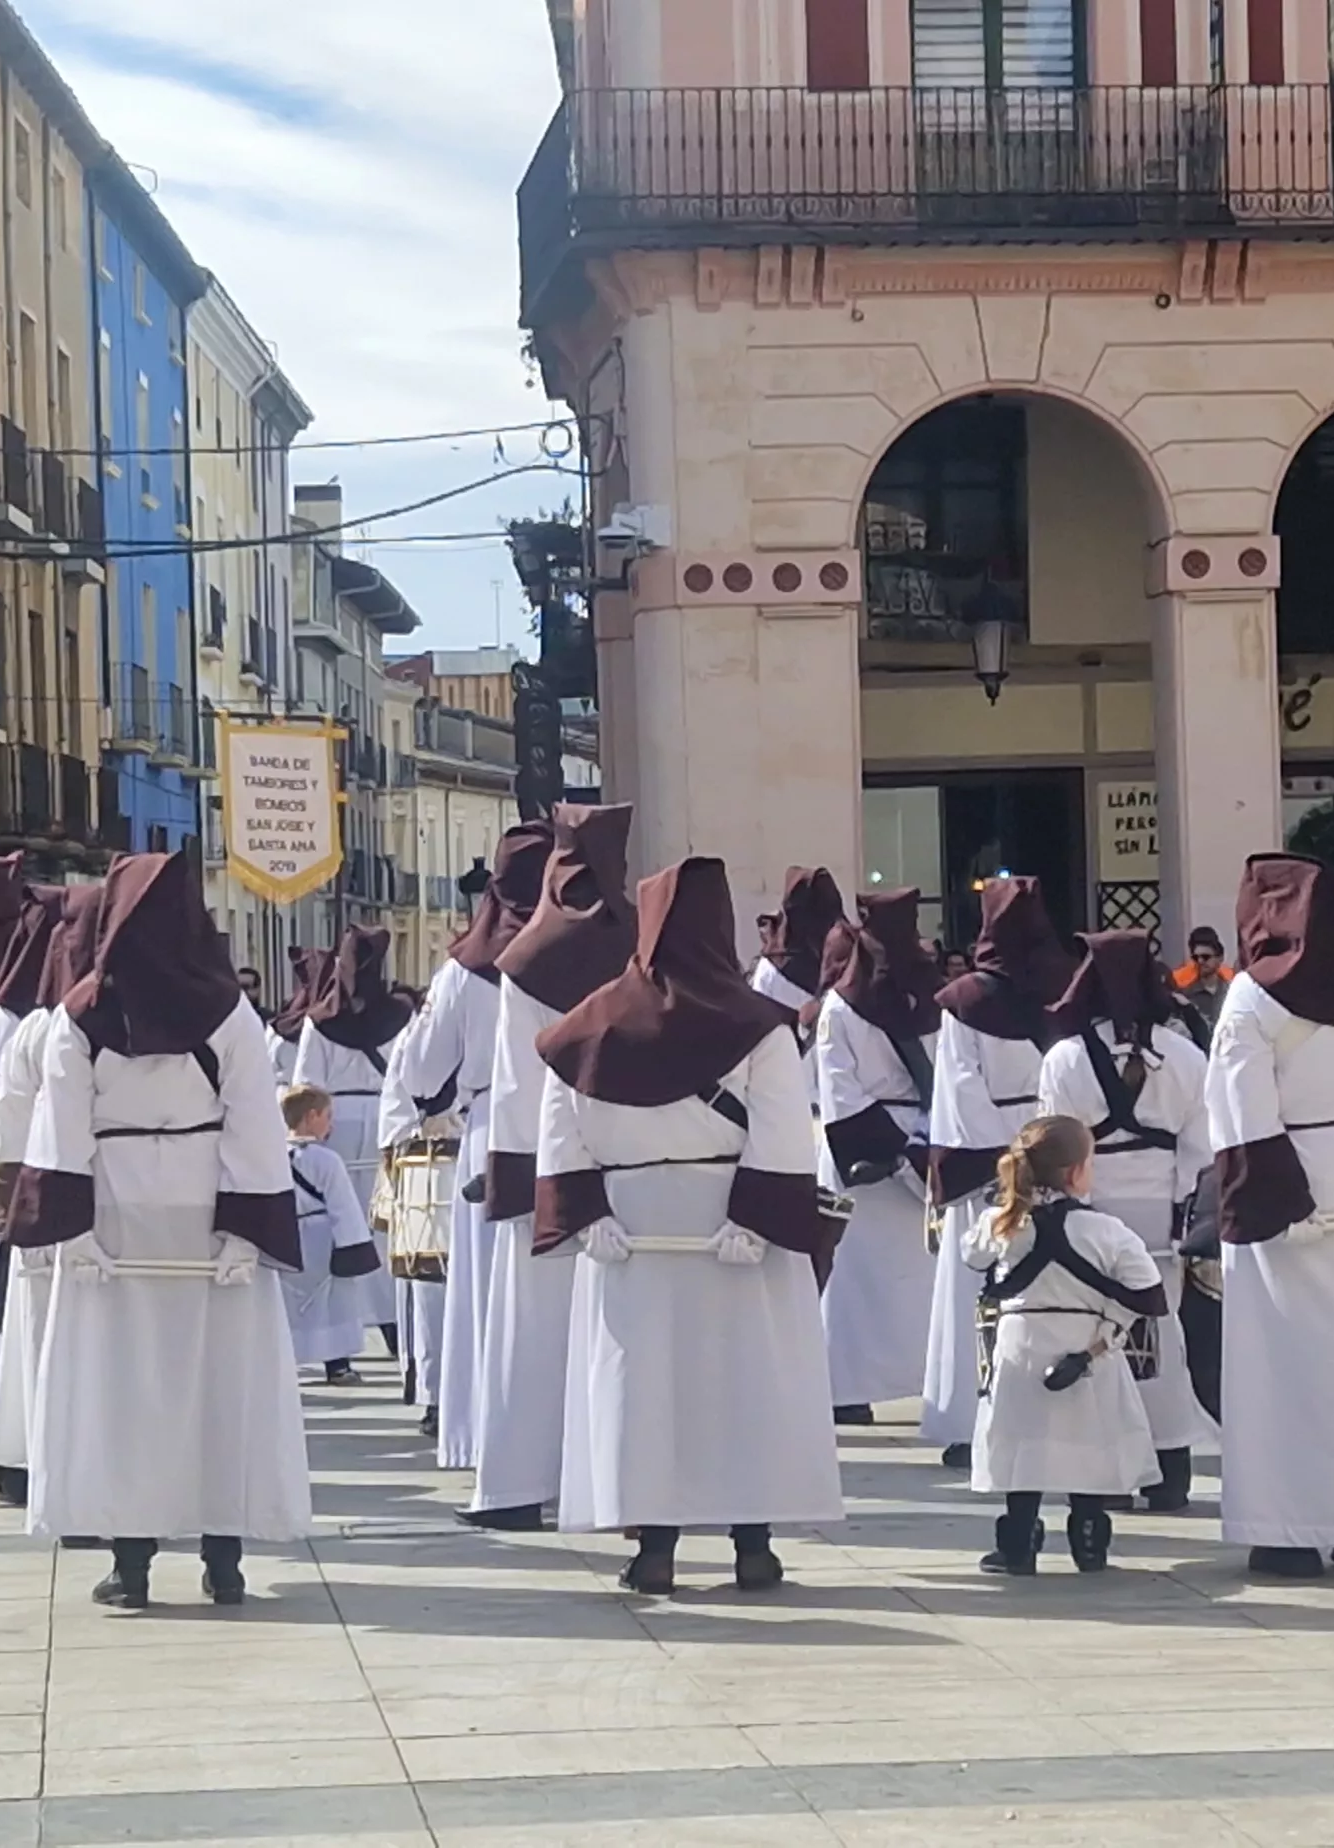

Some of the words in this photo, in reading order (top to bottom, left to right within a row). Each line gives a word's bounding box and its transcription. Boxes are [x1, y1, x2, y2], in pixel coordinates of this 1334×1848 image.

[249, 755, 290, 770] BANDA
[293, 758, 311, 771] DE
[243, 776, 307, 791] TAMBORES
[311, 779, 319, 791] Y
[255, 797, 306, 812] BOMBOS
[247, 819, 272, 832] SAN
[308, 820, 316, 832] Y
[1116, 816, 1157, 831] PERO
[248, 838, 287, 851] SANTA
[290, 840, 316, 852] ANA
[1114, 838, 1140, 855] SIN
